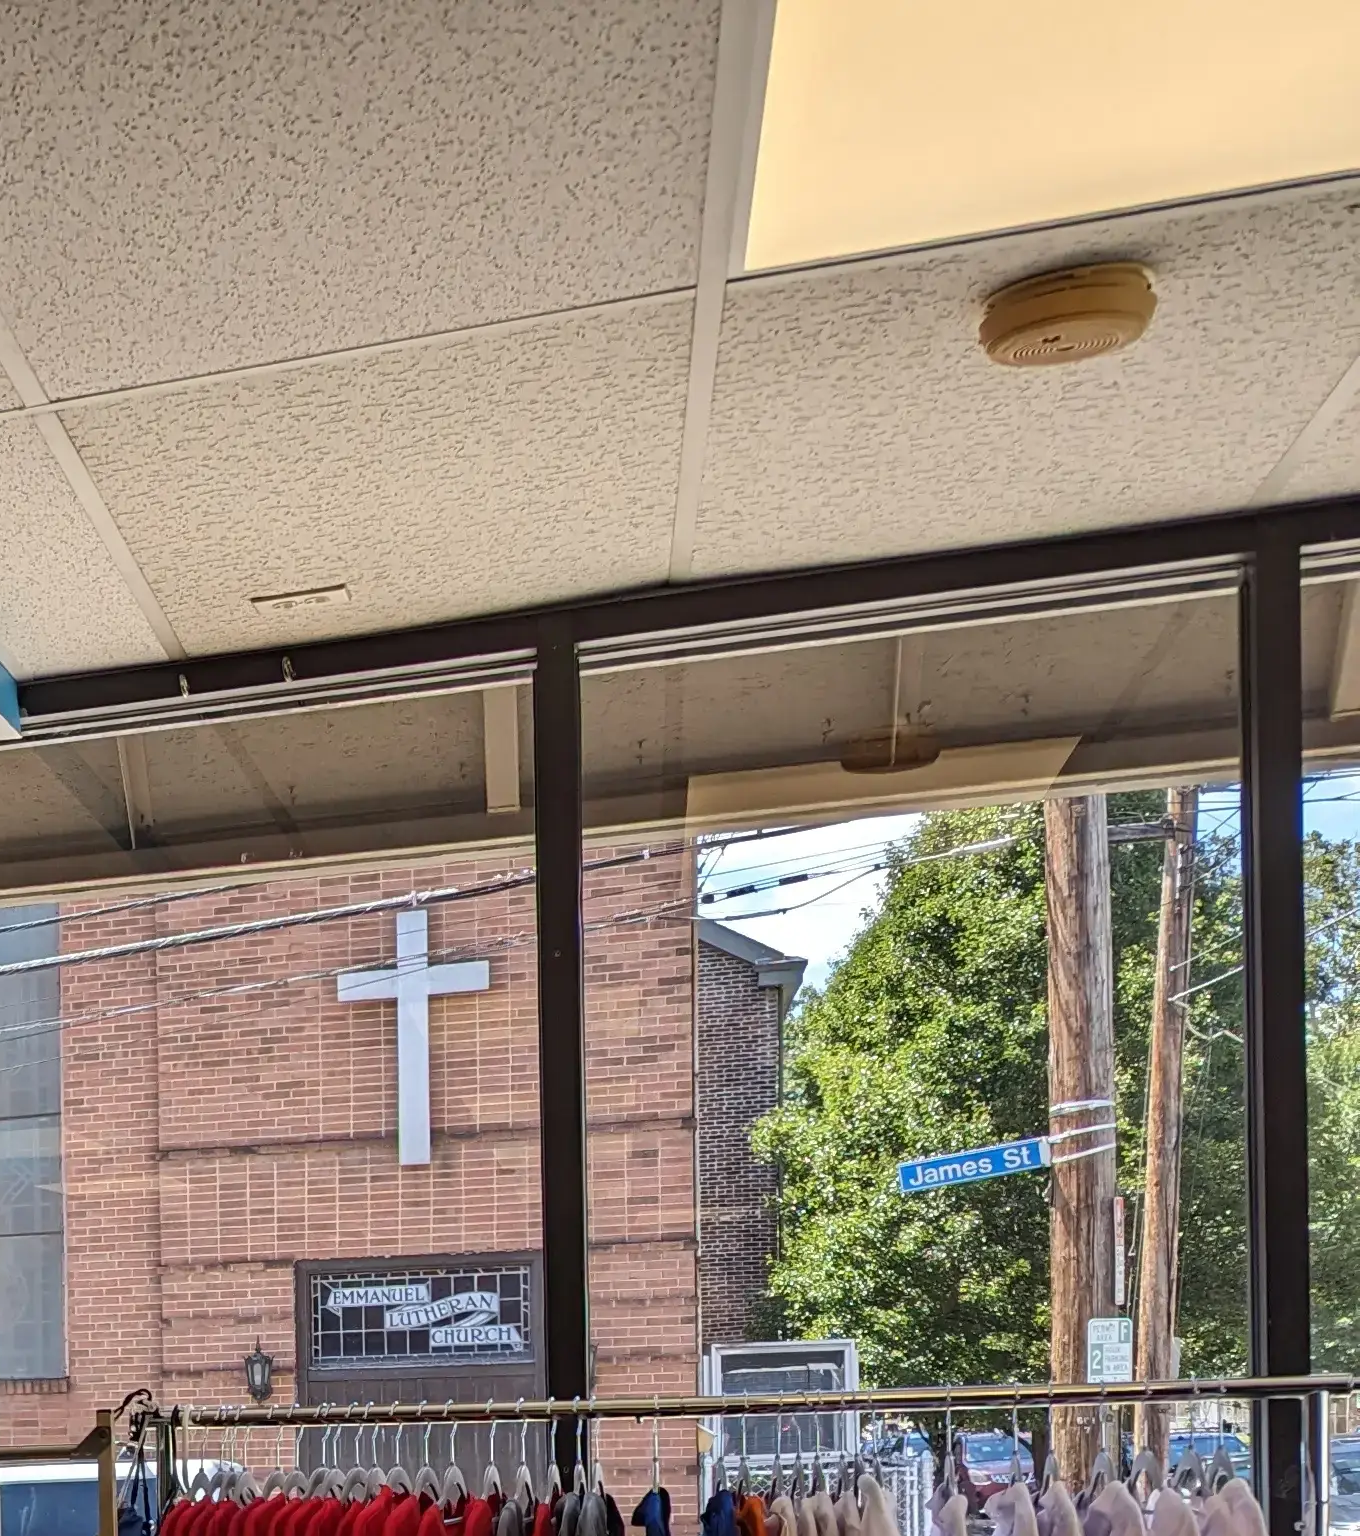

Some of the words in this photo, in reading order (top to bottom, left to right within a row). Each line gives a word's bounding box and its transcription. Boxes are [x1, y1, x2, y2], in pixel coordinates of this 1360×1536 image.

[909, 1157, 993, 1186] James
[1002, 1146, 1032, 1169] St
[333, 1287, 425, 1305] EMMANUEL
[388, 1294, 494, 1328] LUTHERAN
[431, 1327, 512, 1344] CHURCH
[1120, 1322, 1129, 1341] F
[1092, 1349, 1101, 1370] 2
